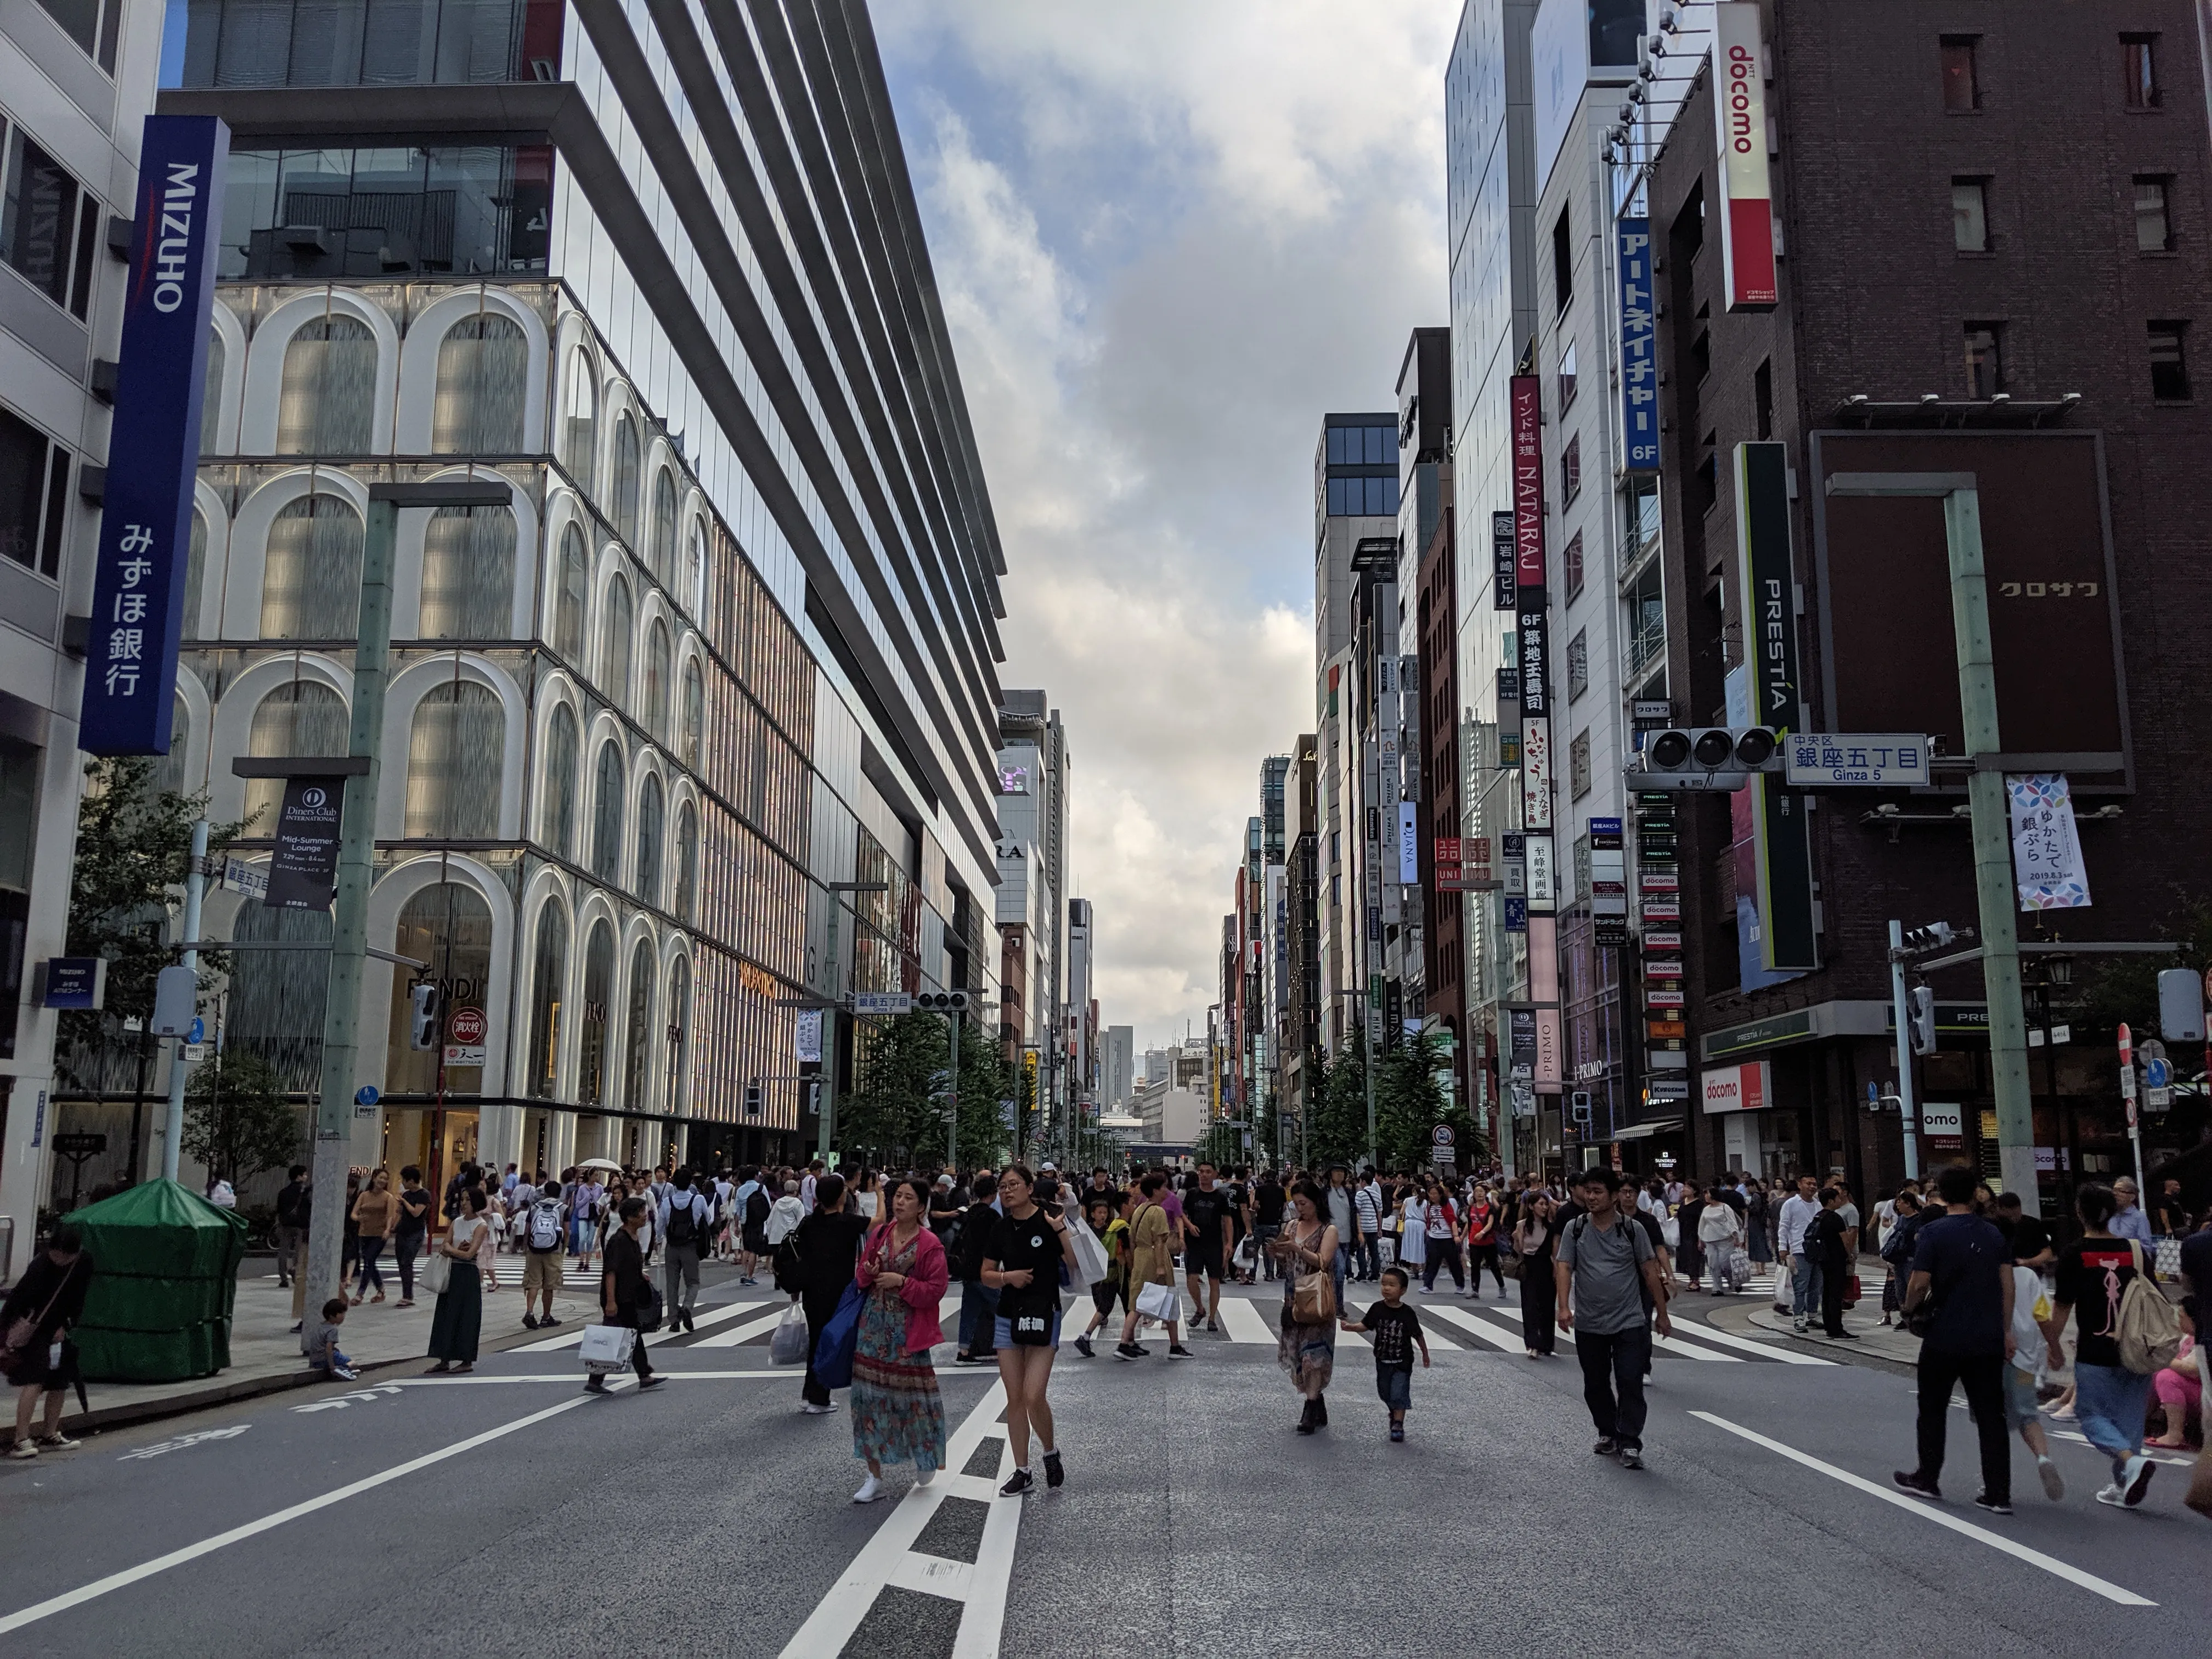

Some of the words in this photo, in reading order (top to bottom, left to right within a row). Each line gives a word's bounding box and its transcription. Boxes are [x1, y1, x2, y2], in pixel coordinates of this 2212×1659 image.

[1729, 46, 1754, 154] docomo
[154, 162, 199, 313] MIZUHO
[1621, 234, 1654, 430] アートネイチャー
[1519, 393, 1536, 456] インド料理
[1632, 445, 1657, 460] 6F
[1519, 466, 1539, 571] NATARAJ
[1499, 545, 1514, 605] 岩崎ビル
[1998, 582, 2097, 597] クロサワ
[106, 524, 153, 696] みずほ銀行
[1522, 614, 1542, 626] 6F
[1765, 579, 1793, 710] PRESTÍA
[1795, 736, 1832, 746] 中央区
[1797, 748, 1918, 768] 銀座五丁目
[1833, 769, 1867, 781] Ginza
[1874, 770, 1881, 780] 5
[287, 806, 314, 815] Diners
[317, 807, 336, 816] Club
[1526, 792, 1537, 824] 焼き鳥
[1539, 787, 1549, 820] うなぎ
[282, 836, 333, 844] Mid-Summer
[1439, 840, 1458, 849] ユニ
[2021, 817, 2039, 861] 銀ぶら
[2041, 810, 2062, 868] ゆかたで
[1439, 851, 1457, 859] クロ
[1510, 868, 1521, 887] 買取
[1534, 847, 1547, 900] 至峰堂画廊
[2030, 872, 2062, 880] 2019.8.3
[859, 997, 907, 1007] 銀座五丁目
[455, 1021, 480, 1033] 消火栓
[1957, 1013, 1989, 1022] PRE
[1542, 1025, 1553, 1081] -PRIMO
[1575, 1060, 1602, 1080] I-PRIMO
[1707, 1080, 1737, 1099] docomo
[1925, 1116, 1957, 1125] omo
[349, 1166, 372, 1175] ENDI
